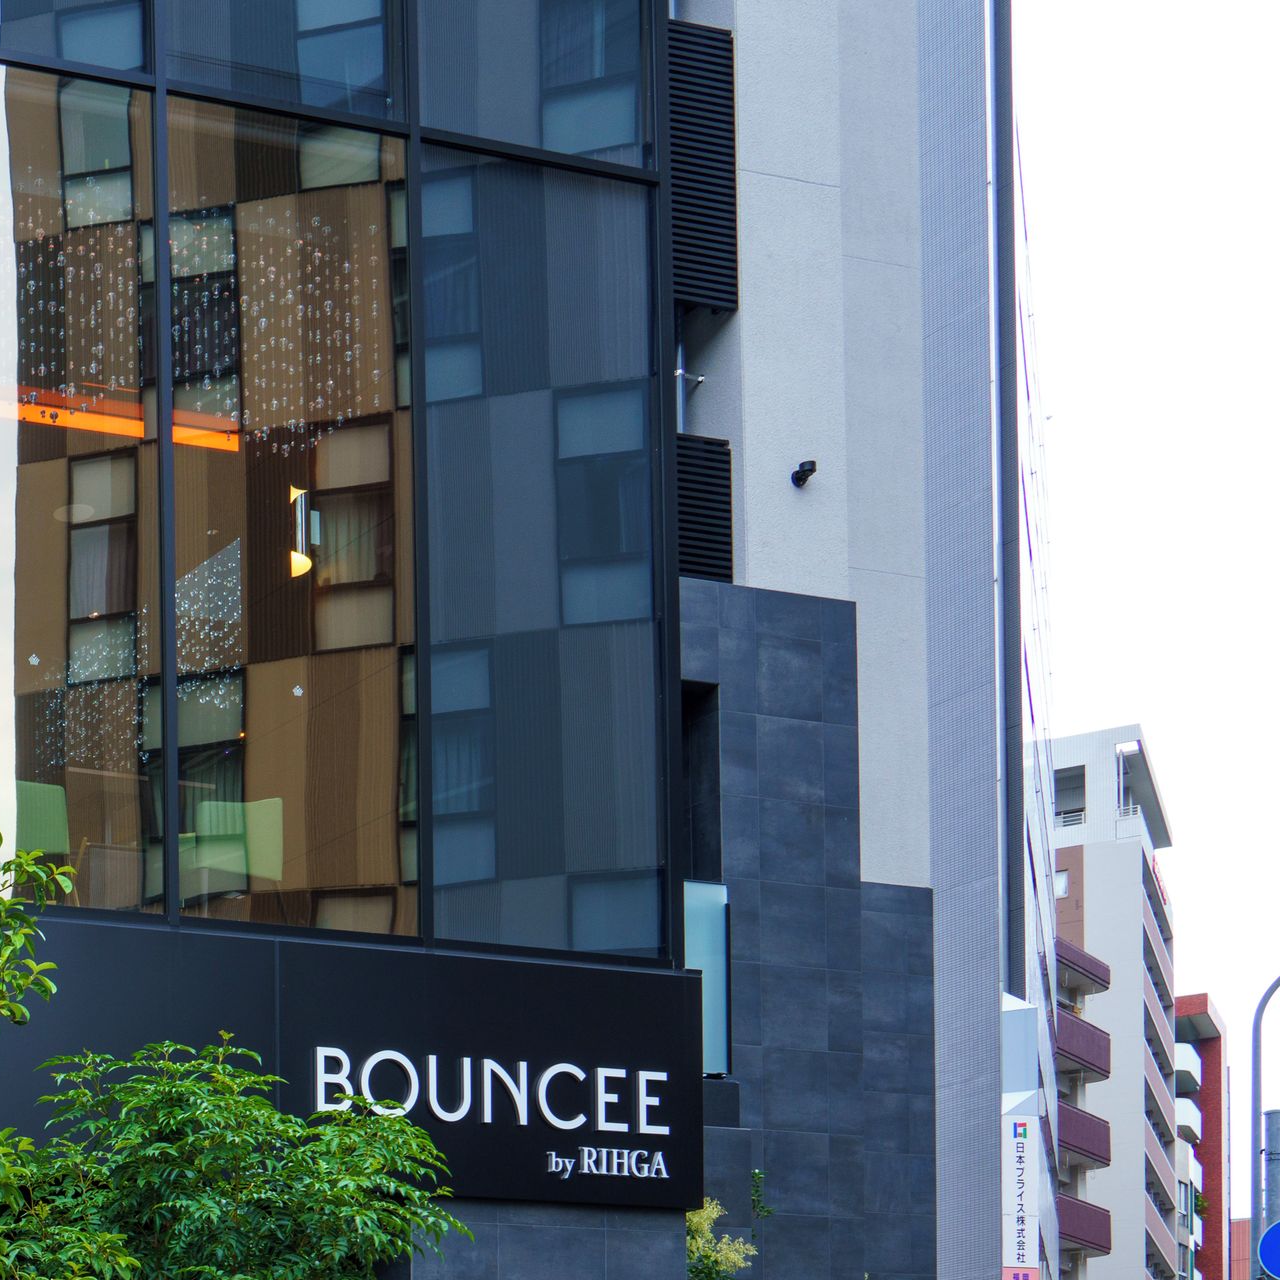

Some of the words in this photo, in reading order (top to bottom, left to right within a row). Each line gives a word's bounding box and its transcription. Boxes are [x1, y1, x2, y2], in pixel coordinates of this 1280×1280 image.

[315, 1046, 670, 1136] BOUNCEE
[547, 1150, 576, 1180] by
[579, 1146, 670, 1179] RIHGA
